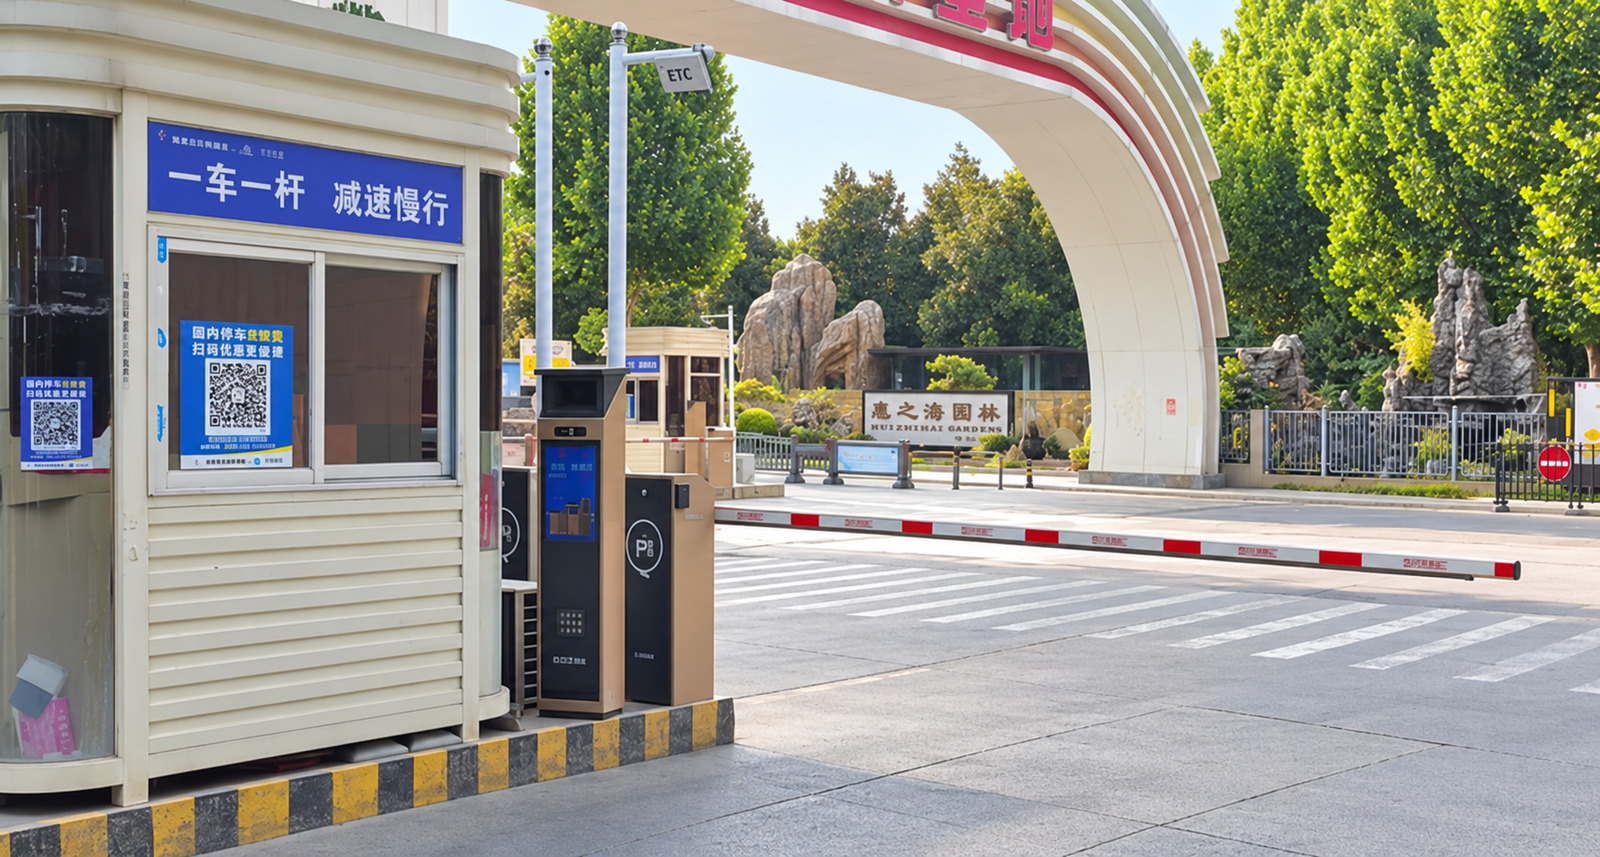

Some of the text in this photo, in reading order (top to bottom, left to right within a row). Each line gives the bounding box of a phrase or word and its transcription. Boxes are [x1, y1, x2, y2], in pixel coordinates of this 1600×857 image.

[667, 67, 693, 82] ETC
[168, 162, 449, 227] 一车一杆 减速慢行
[947, 425, 1002, 433] GARDENS
